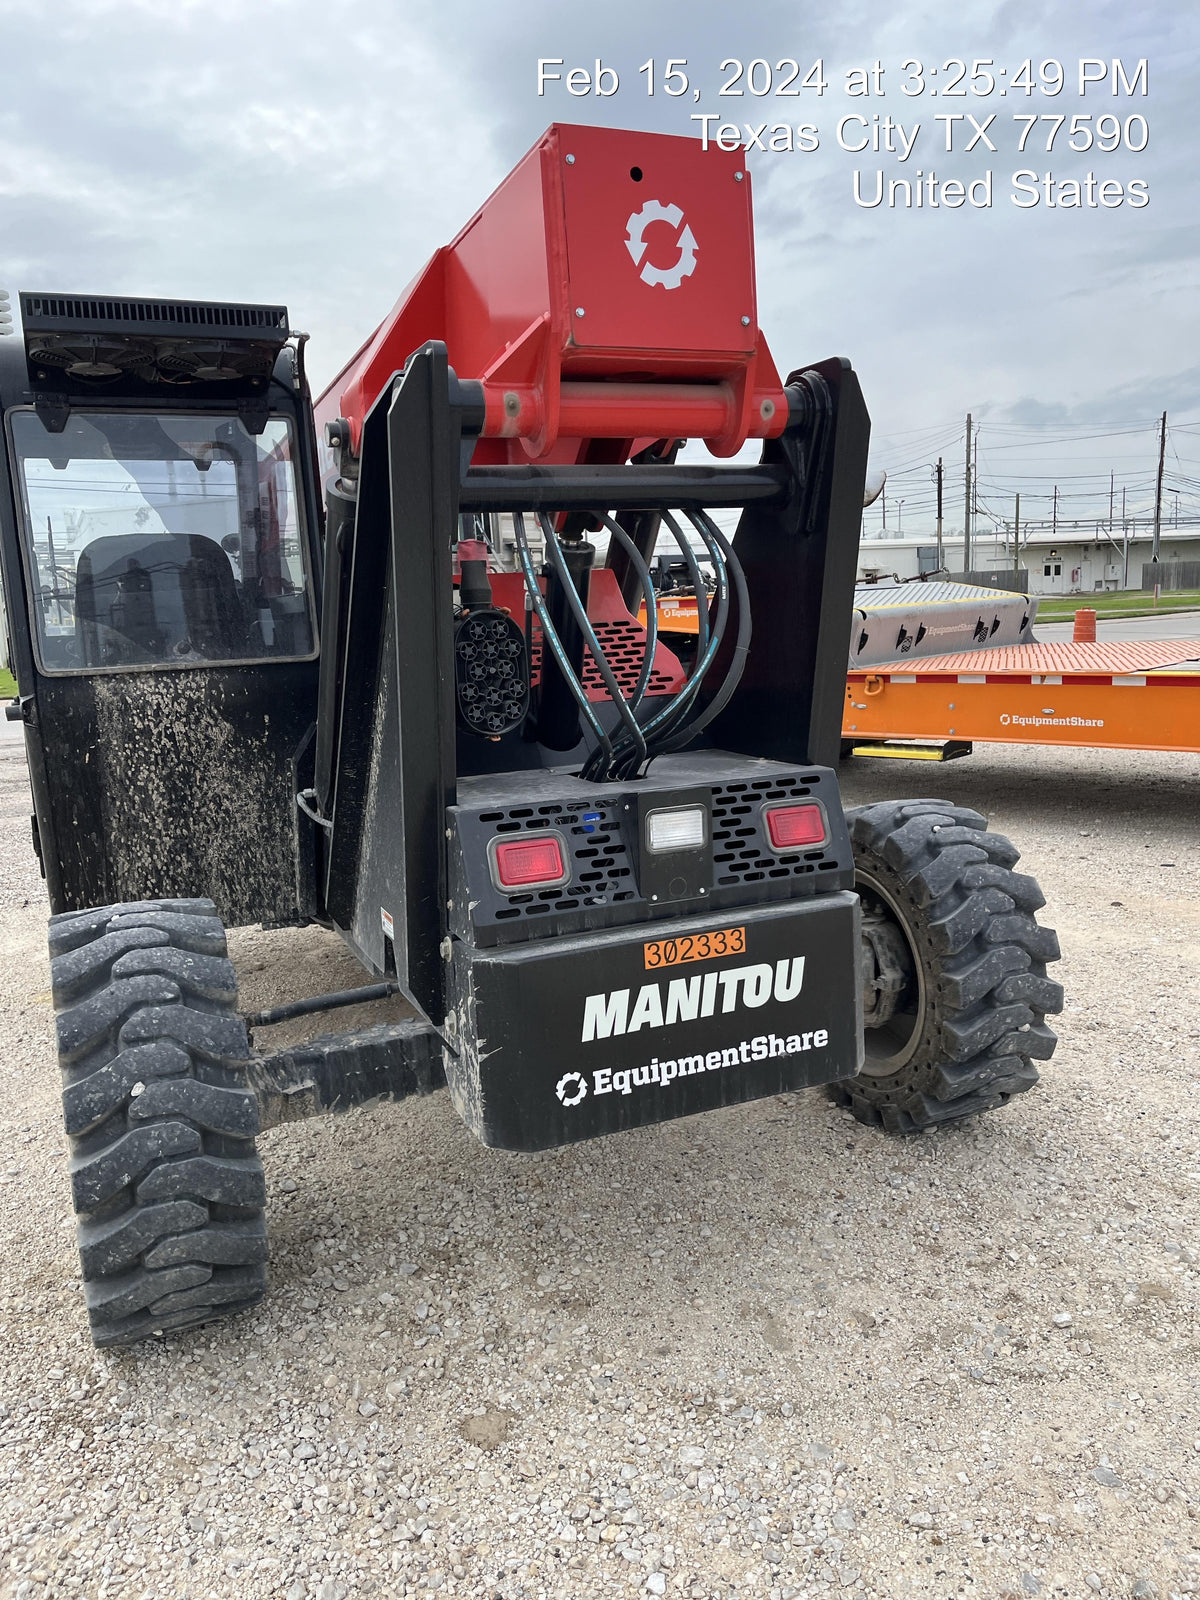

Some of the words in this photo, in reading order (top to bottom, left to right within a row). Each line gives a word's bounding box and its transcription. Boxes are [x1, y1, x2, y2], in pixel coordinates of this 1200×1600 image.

[1012, 715, 1104, 727] EquipmentShare
[647, 929, 744, 966] 302333
[581, 956, 806, 1042] MANITOU
[593, 1029, 829, 1095] EquipmentShare
